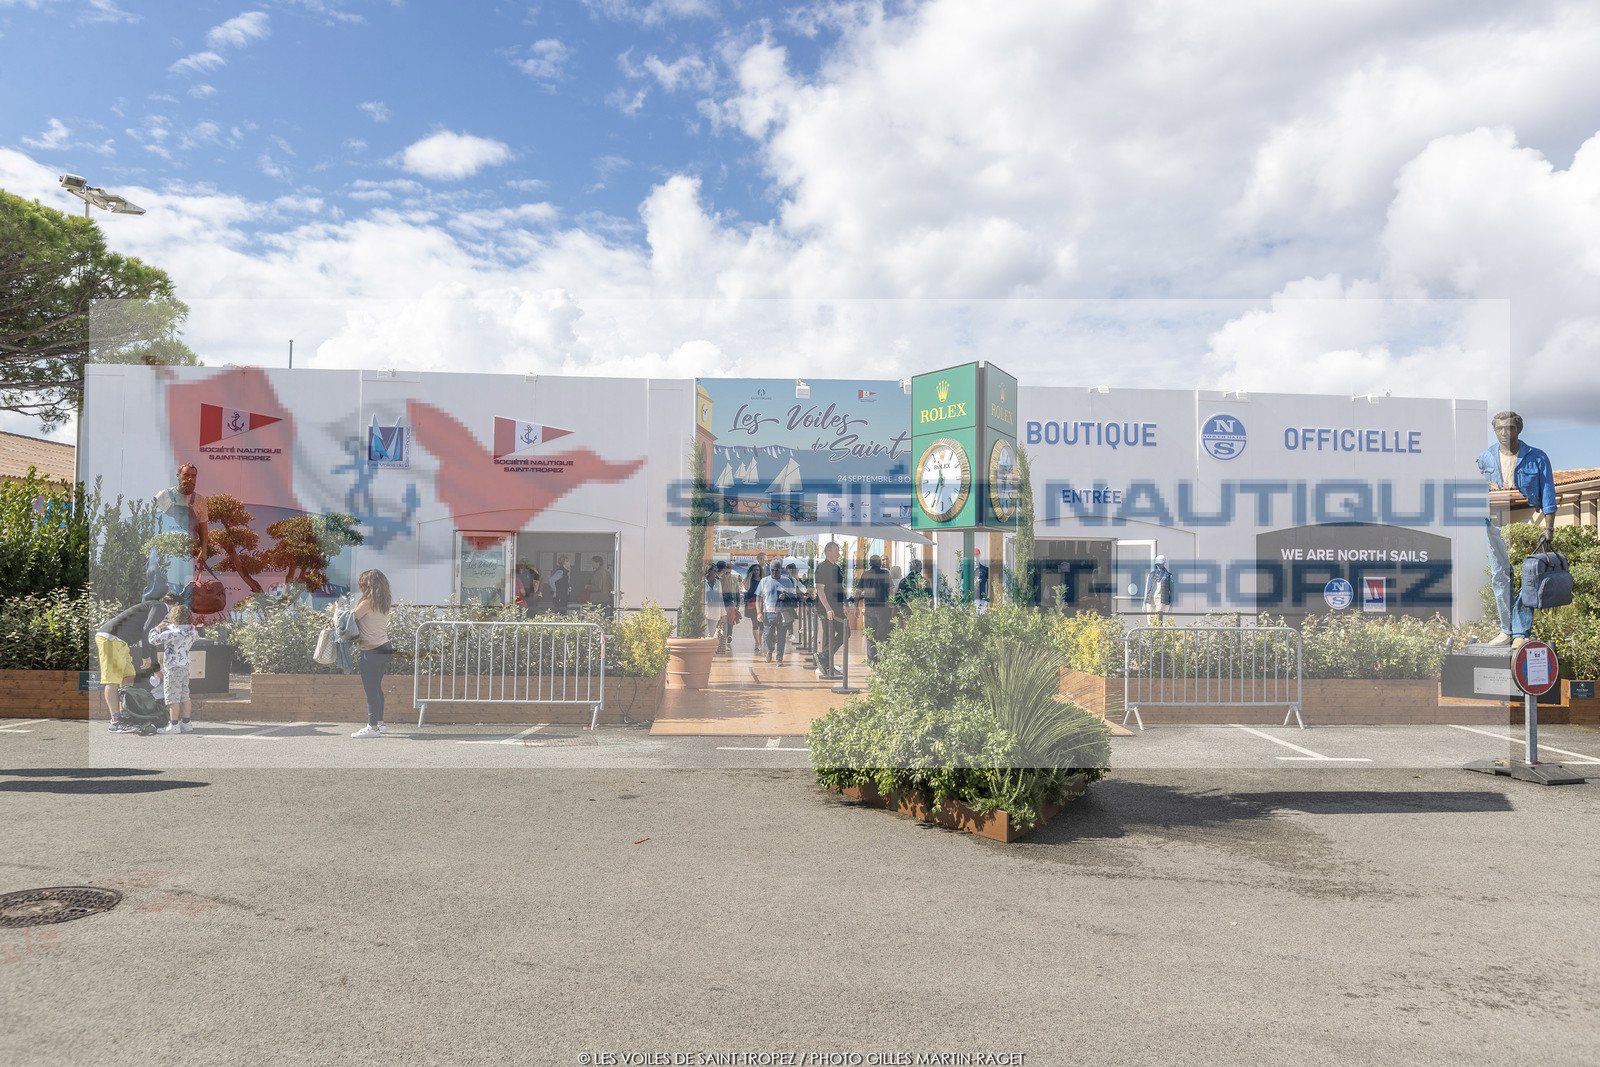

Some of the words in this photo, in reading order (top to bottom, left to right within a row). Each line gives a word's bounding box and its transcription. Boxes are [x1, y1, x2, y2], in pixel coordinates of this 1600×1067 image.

[727, 404, 780, 435] Les
[786, 402, 869, 436] Voiles
[920, 402, 967, 424] ROLEX
[991, 403, 1014, 425] ROLEX
[1026, 420, 1157, 450] BOUTIQUE
[1213, 419, 1236, 433] N
[810, 436, 829, 451] de
[827, 430, 911, 462] Saint-
[1213, 442, 1236, 455] S
[1284, 427, 1422, 453] OFFICIELLE
[199, 446, 236, 454] SOCIÉTÉ
[493, 458, 529, 466] SOCIÉTÉ
[837, 475, 847, 483] 24
[847, 475, 892, 483] SEPTEMBRE
[1062, 486, 1122, 504] ENTRÉE
[1280, 548, 1303, 561] WE
[1306, 549, 1334, 561] ARE
[1337, 549, 1387, 562] NORTH
[1390, 550, 1428, 563] SAILS
